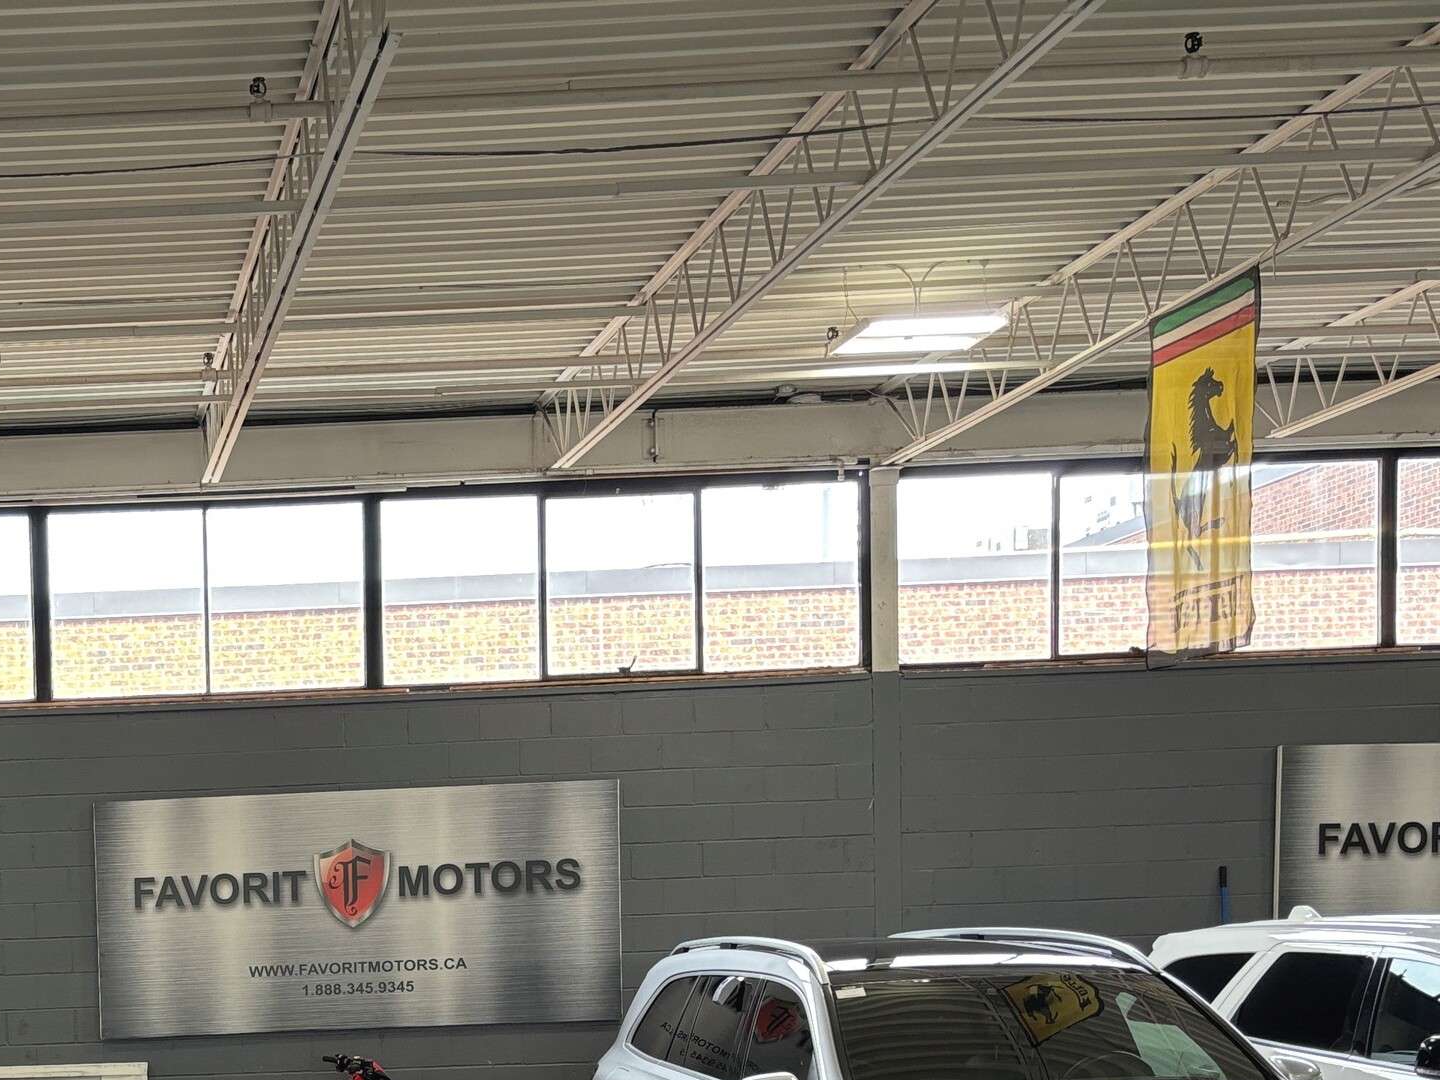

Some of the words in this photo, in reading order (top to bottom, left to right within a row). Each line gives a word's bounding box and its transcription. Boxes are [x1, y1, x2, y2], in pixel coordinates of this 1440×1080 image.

[1317, 821, 1440, 856] FAVO
[132, 869, 307, 909] FAVORIT
[398, 857, 581, 898] MOTORS
[248, 957, 468, 979] WWW.FAVORITMOTORS.CA
[301, 980, 415, 998] 1.888.345.9345
